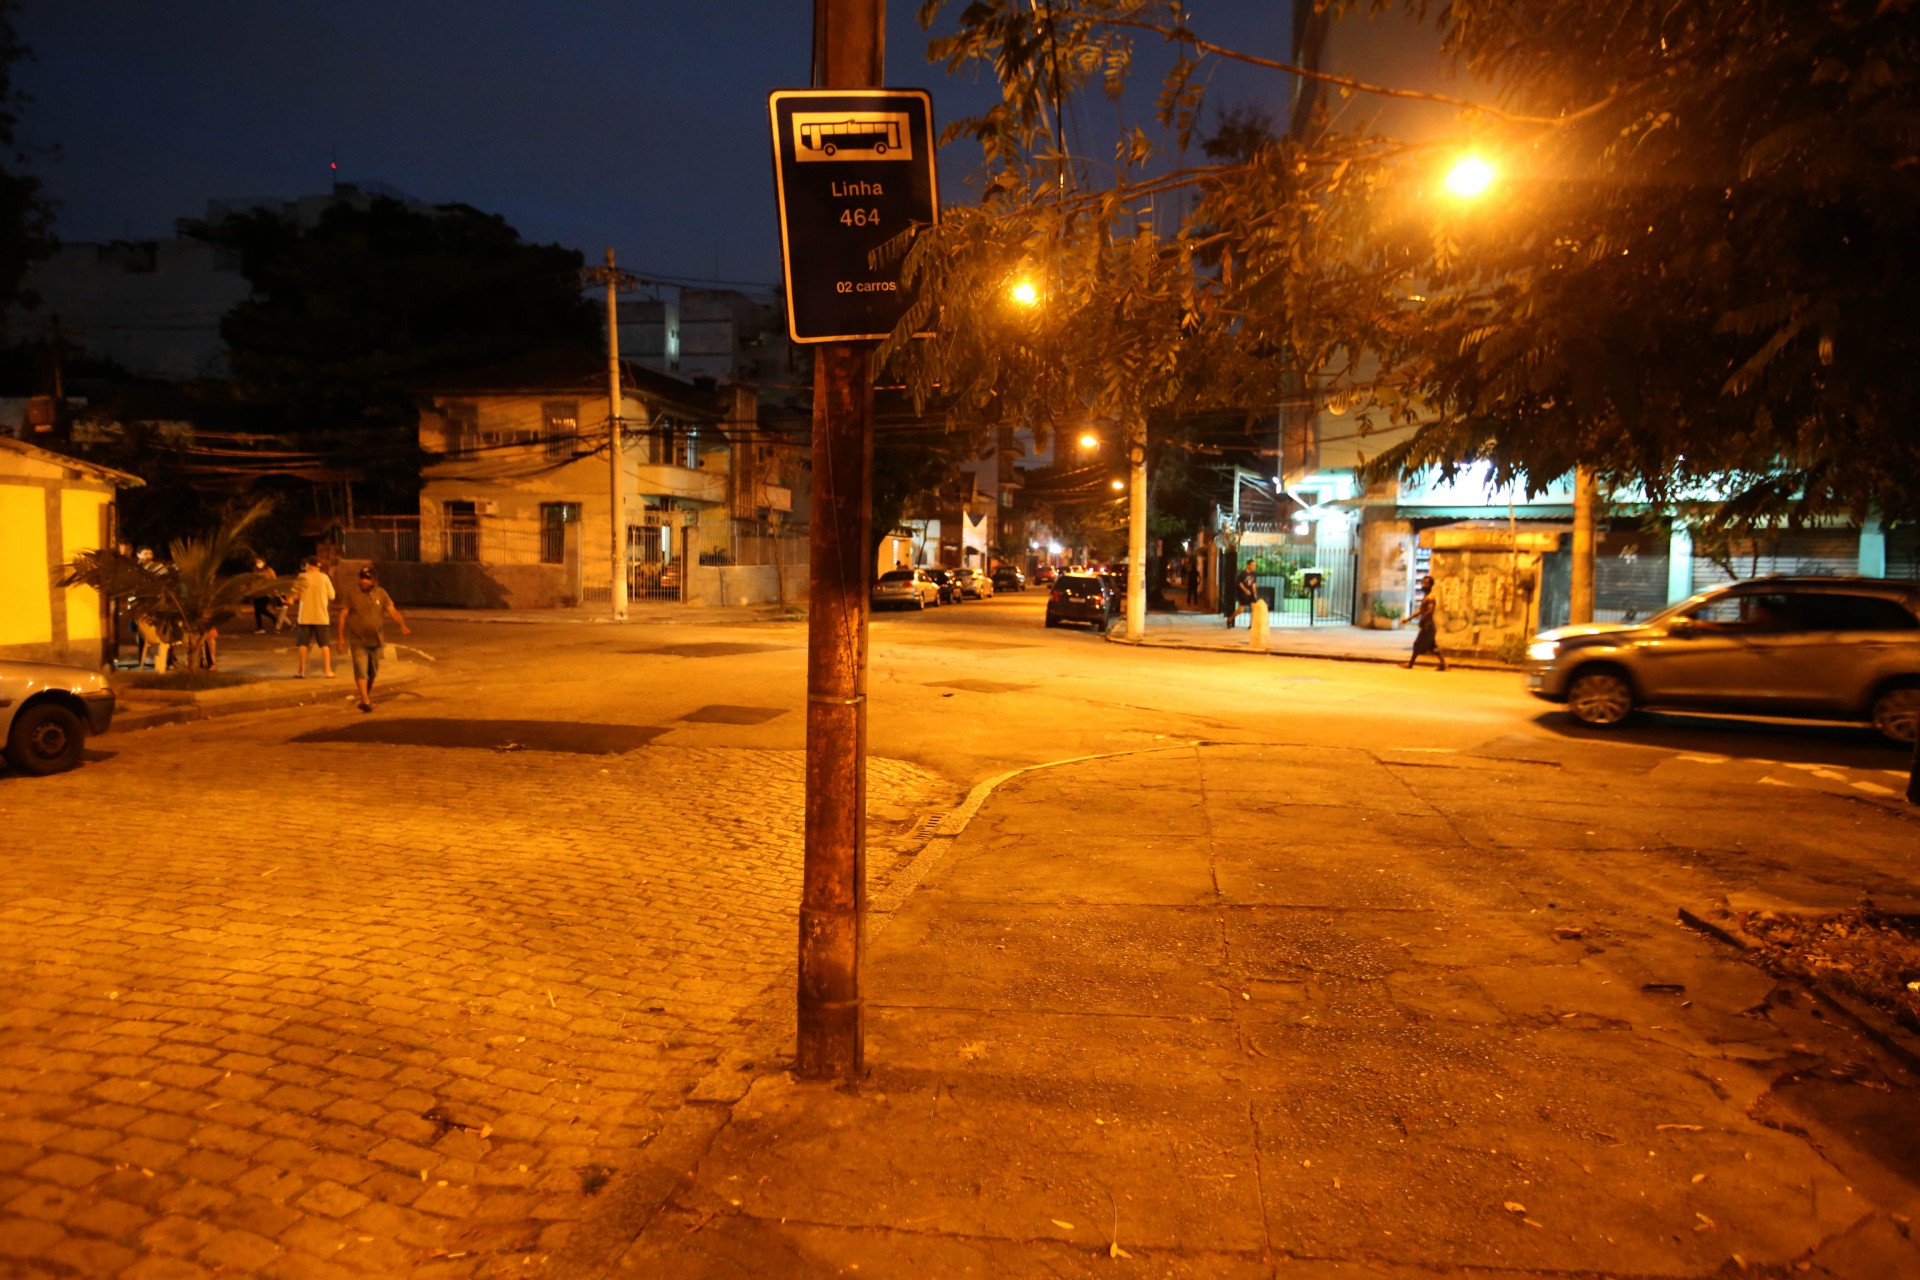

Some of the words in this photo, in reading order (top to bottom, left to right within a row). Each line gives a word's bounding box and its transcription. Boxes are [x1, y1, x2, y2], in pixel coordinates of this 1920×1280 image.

[832, 181, 883, 197] Linha
[840, 208, 880, 226] 464
[836, 281, 853, 293] 02
[856, 281, 897, 292] carros
